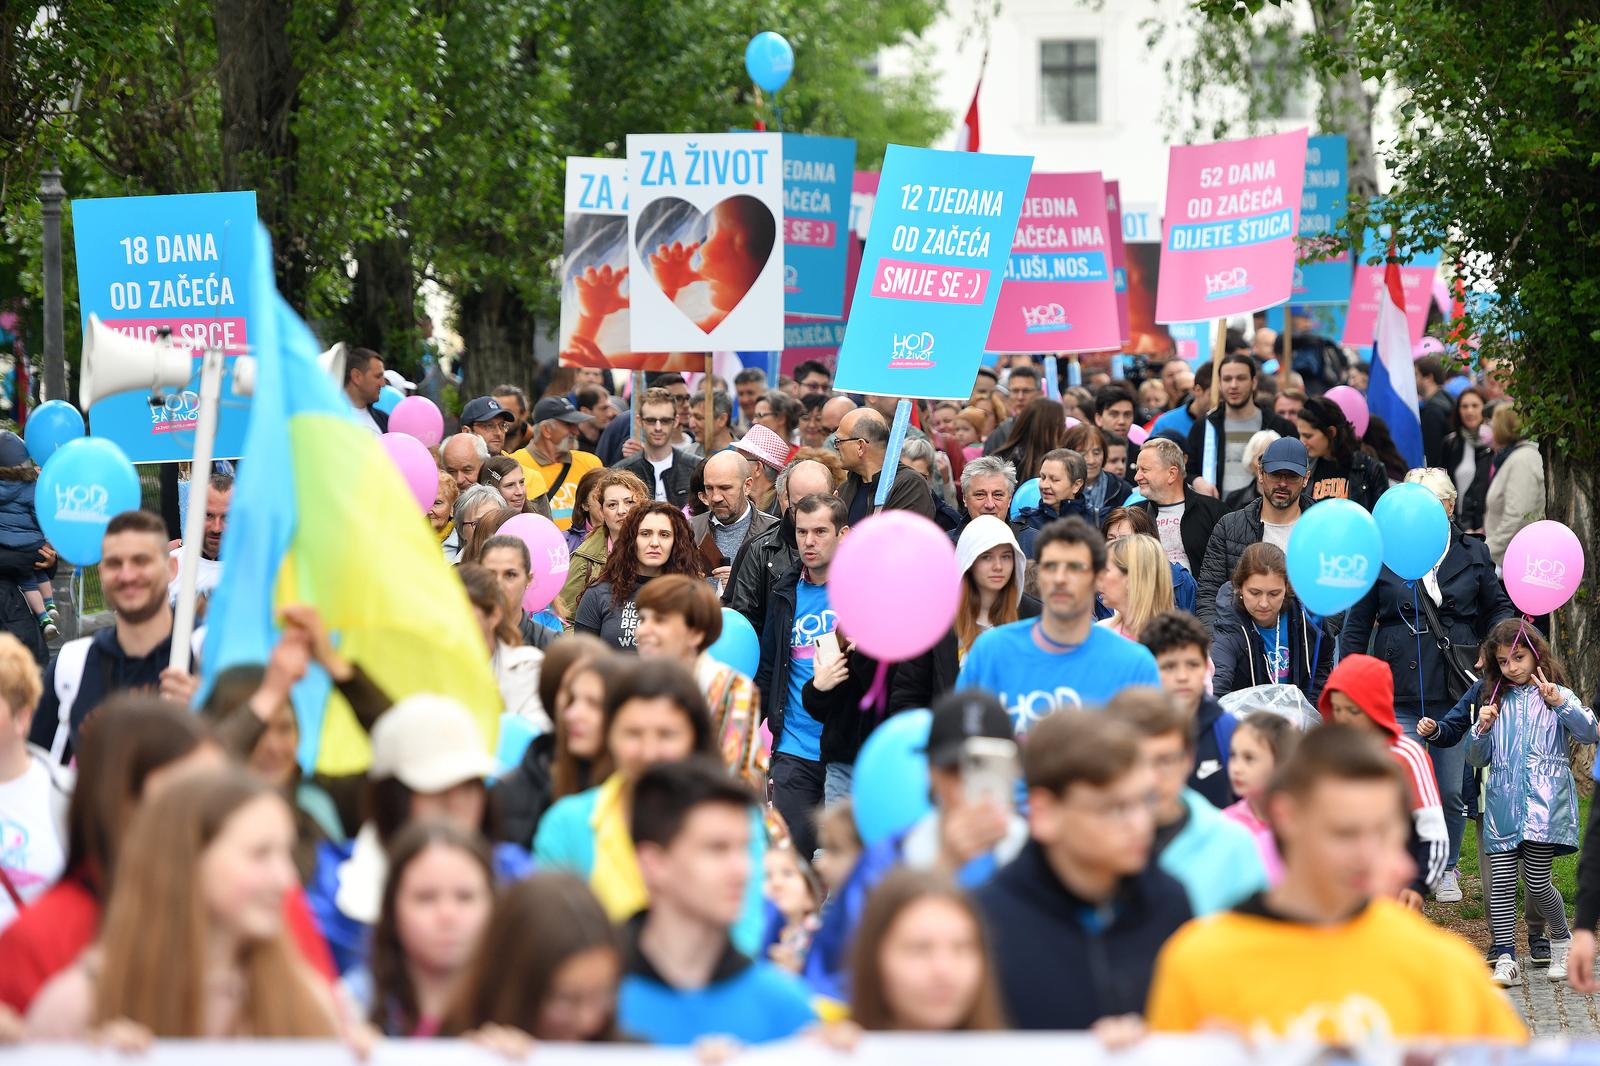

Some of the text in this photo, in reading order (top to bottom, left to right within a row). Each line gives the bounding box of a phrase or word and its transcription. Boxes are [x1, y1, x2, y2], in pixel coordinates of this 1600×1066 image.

[640, 142, 768, 186] ZA ŽIVOT
[783, 160, 836, 183] EDANA
[1200, 159, 1276, 188] 52 DANA
[578, 174, 614, 210] ZA
[783, 187, 832, 214] AČEĆA
[901, 183, 1004, 217] 12 TJEDANA
[1187, 197, 1212, 219] OD
[1216, 185, 1283, 216] ZAČEĆA
[1019, 197, 1079, 218] JEDNA
[891, 224, 991, 258] OD ZAČEĆA
[1012, 224, 1105, 249] AČEĆA IMA
[1173, 212, 1290, 249] DIJETE ŠTUCA
[119, 233, 219, 264] 18 DANA
[110, 272, 235, 310] OD ZAČEĆA
[880, 266, 938, 296] SMIJE
[938, 271, 963, 298] SE
[180, 321, 237, 352] SRCE
[893, 331, 935, 352] HOD
[147, 390, 200, 418] HOD
[55, 483, 109, 510] HOD
[552, 482, 578, 501] OD
[1318, 551, 1369, 577] HOD
[1526, 554, 1566, 577] HOD
[624, 628, 635, 637] IN
